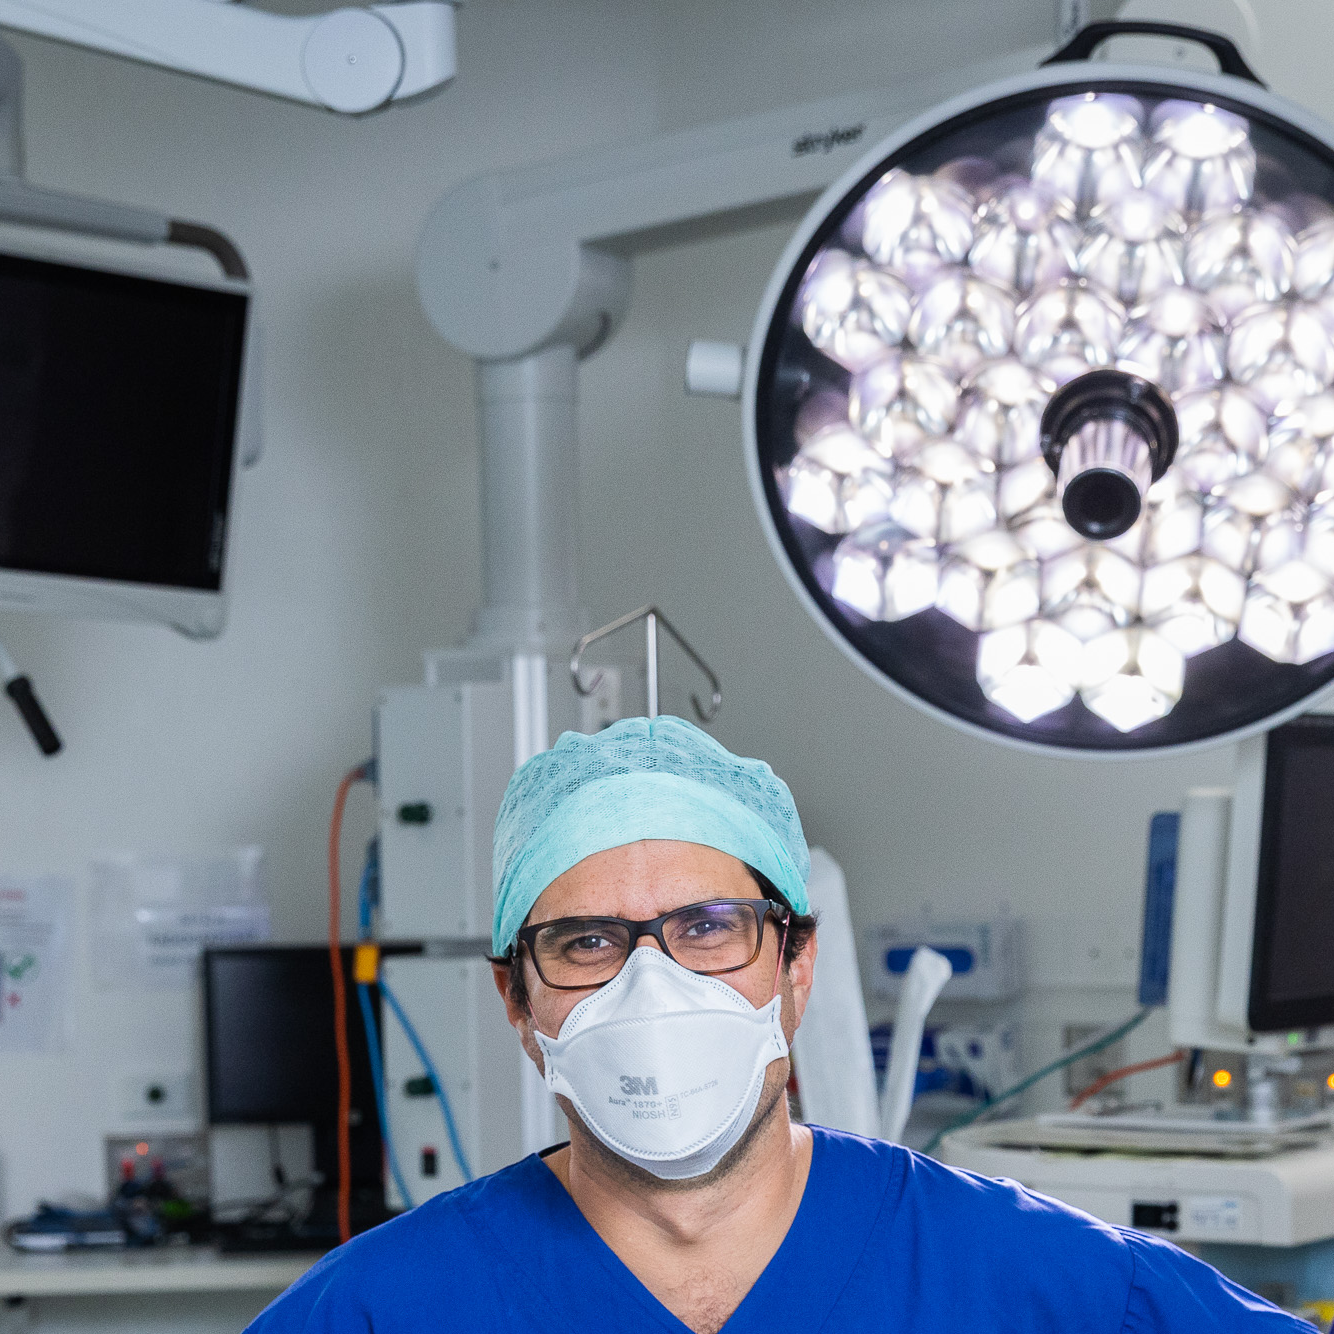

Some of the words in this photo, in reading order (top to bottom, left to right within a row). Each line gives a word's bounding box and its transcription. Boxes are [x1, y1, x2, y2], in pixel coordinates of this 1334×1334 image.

[620, 1075, 658, 1095] 3M
[633, 1101, 663, 1109] 1870+
[668, 1097, 679, 1117] N95
[632, 1110, 666, 1119] NIOSH
